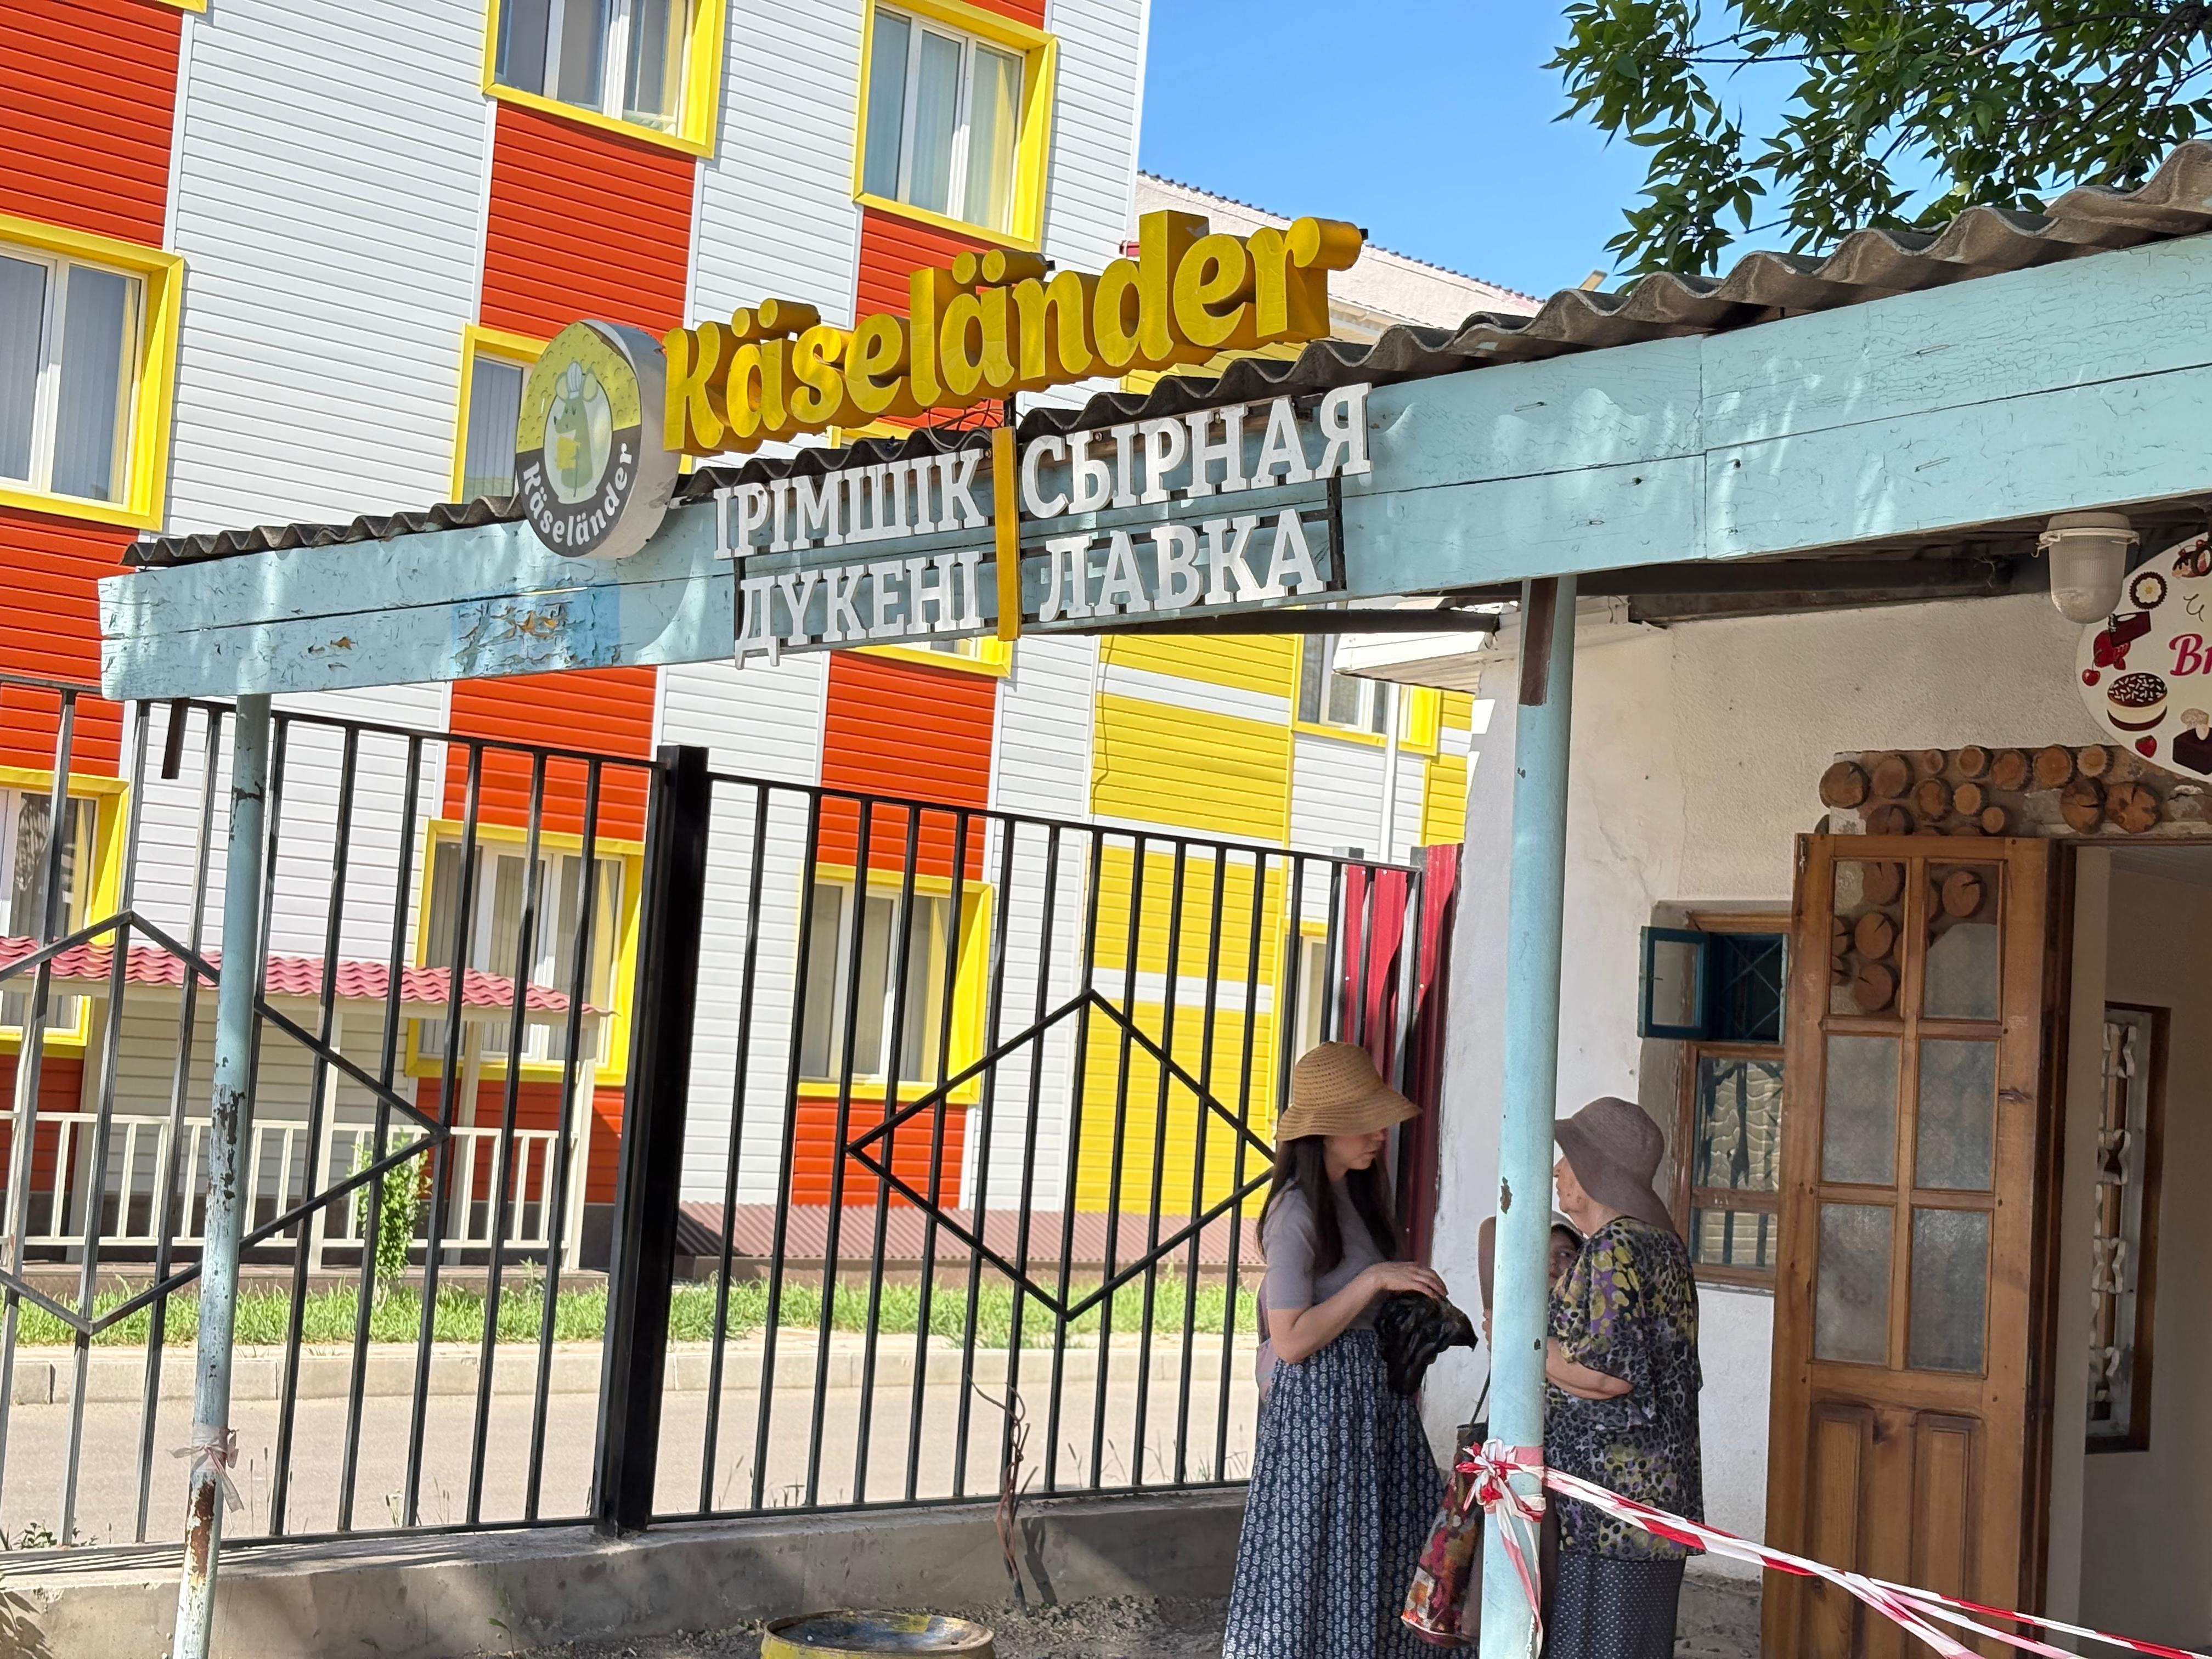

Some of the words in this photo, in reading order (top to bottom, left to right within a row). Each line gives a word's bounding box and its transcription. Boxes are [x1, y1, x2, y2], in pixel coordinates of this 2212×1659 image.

[663, 210, 1321, 453] Käseländer
[523, 443, 632, 546] Käseländer
[714, 448, 986, 560] ІРІМШІК
[1022, 382, 1372, 518] СЫРНАЯ
[735, 550, 984, 669] ДҮКЕНІ
[1039, 509, 1327, 622] ЛАВКА
